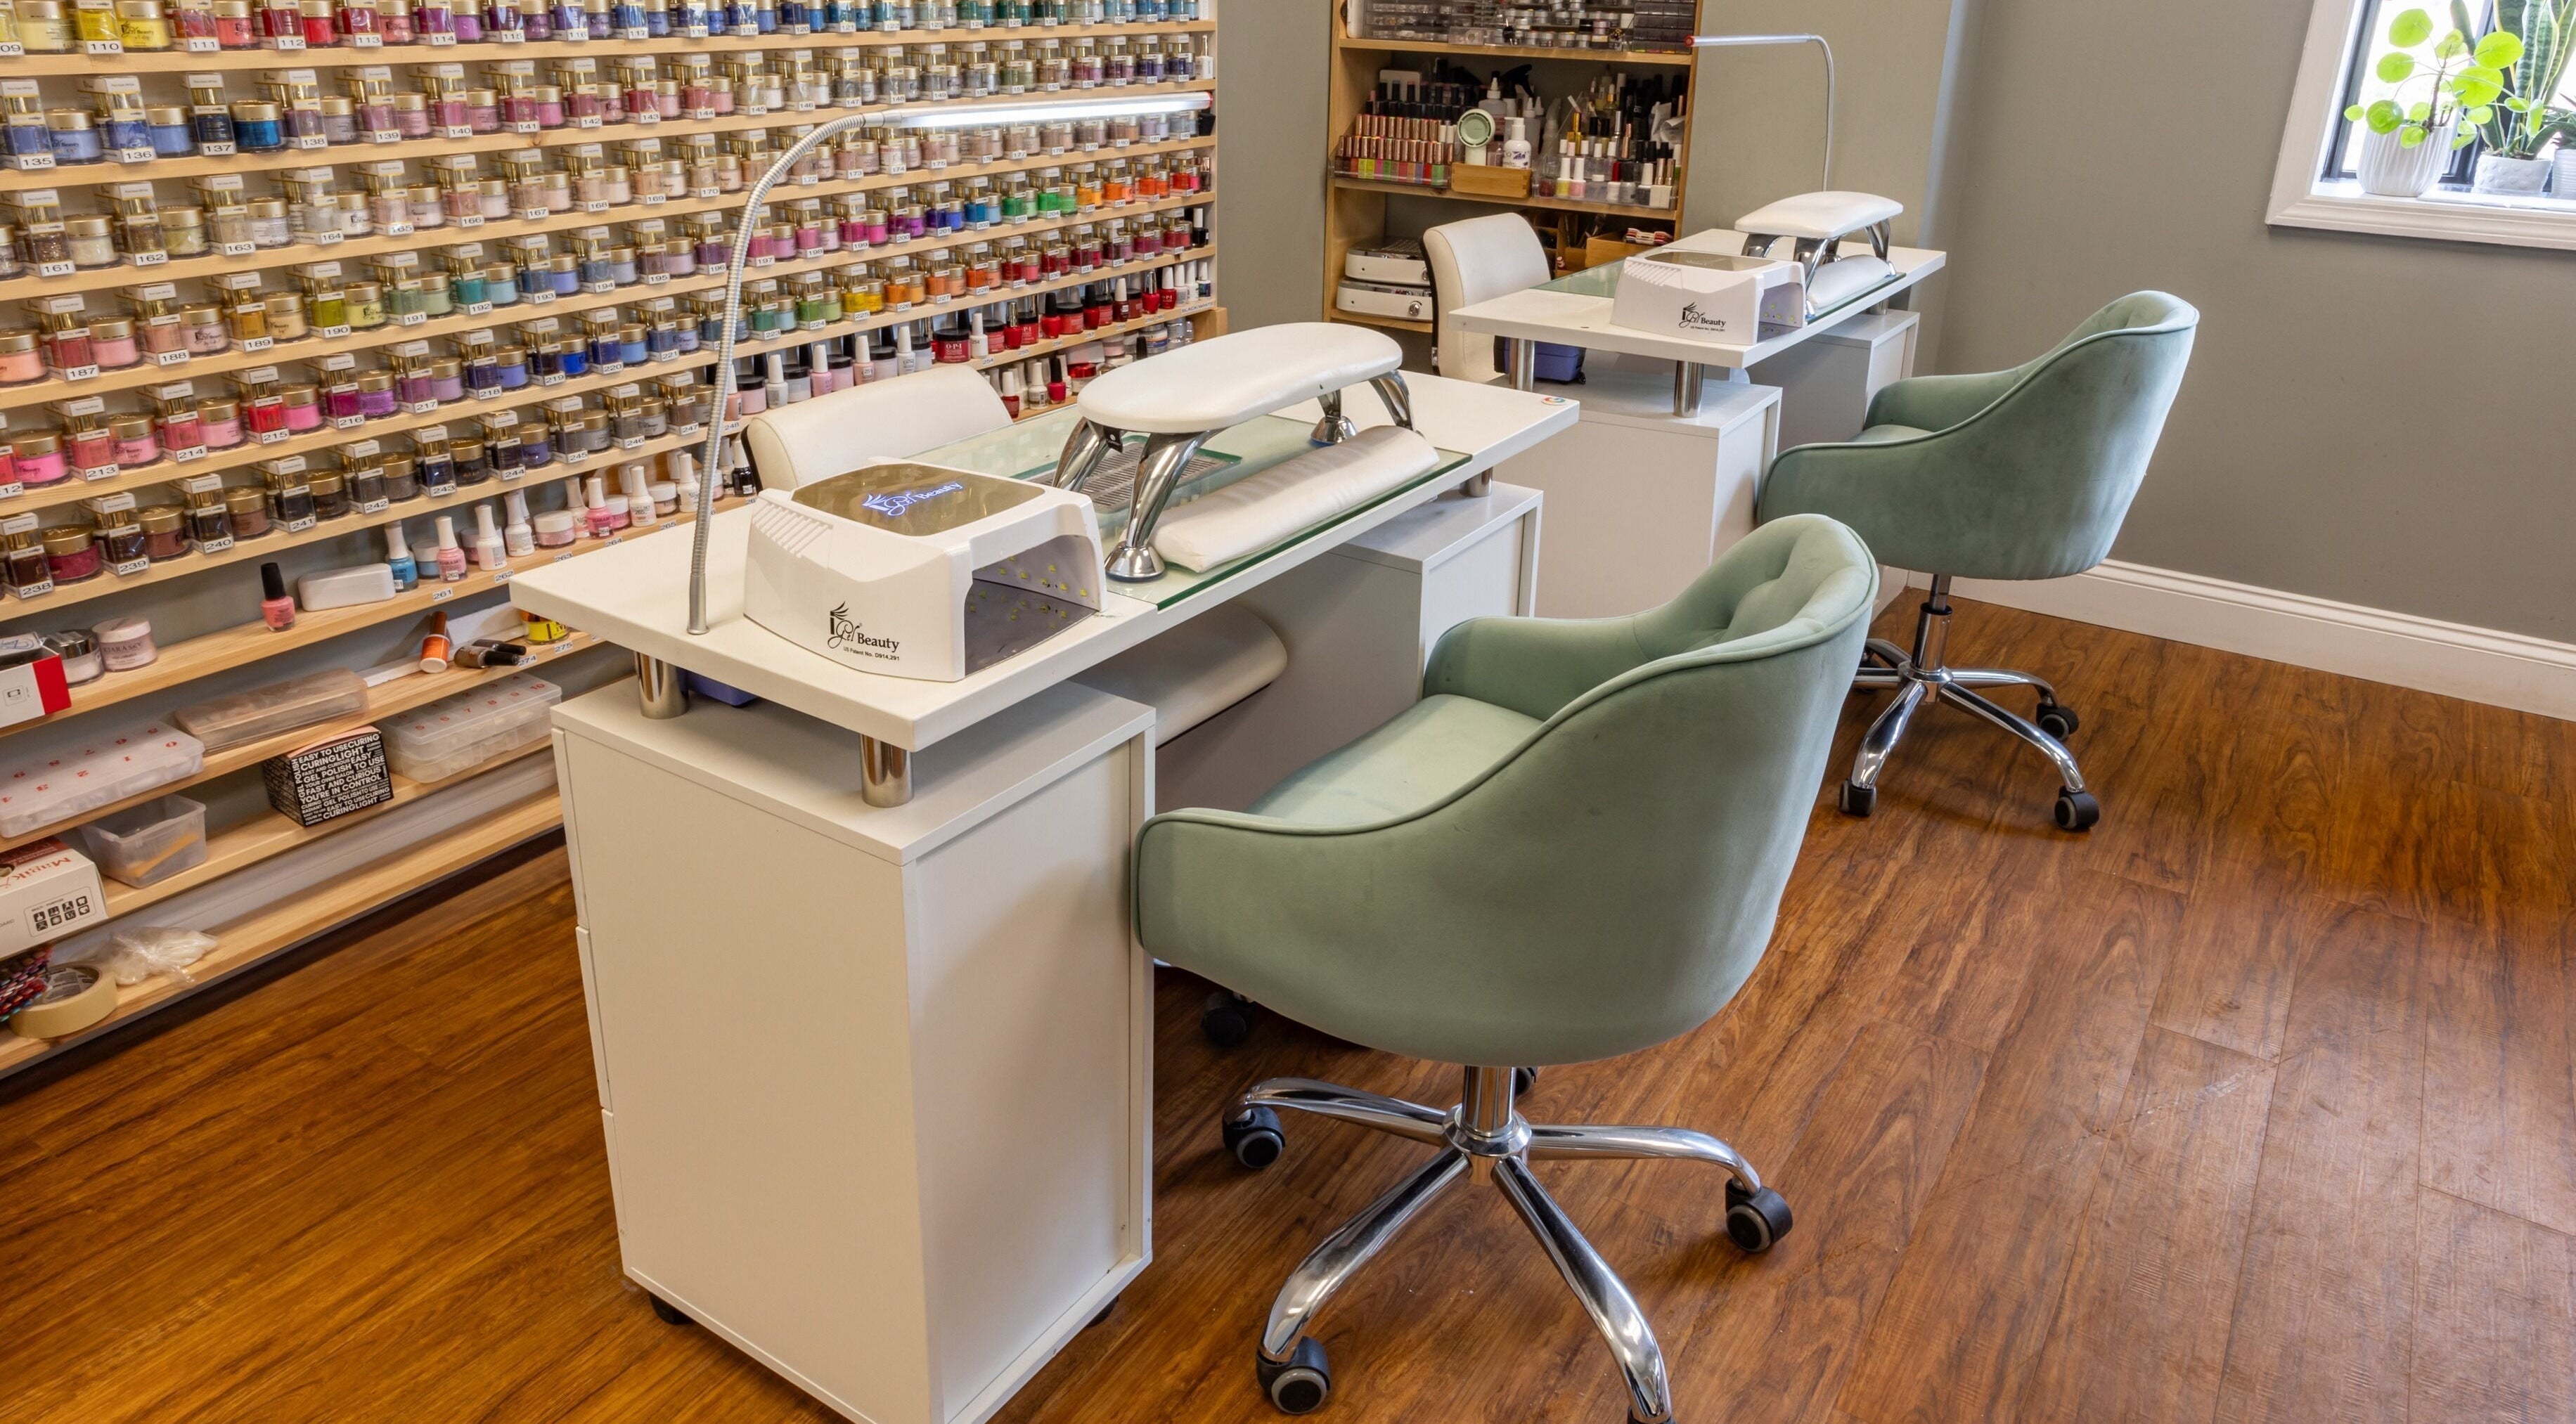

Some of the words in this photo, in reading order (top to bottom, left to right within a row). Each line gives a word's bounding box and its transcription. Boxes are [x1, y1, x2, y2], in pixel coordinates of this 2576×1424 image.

[281, 39, 304, 47] 112
[358, 36, 380, 44] 113
[0, 44, 21, 53] 09
[90, 42, 120, 51] 110
[192, 41, 217, 49] 111
[751, 105, 766, 114] 145
[799, 101, 814, 110] 146
[642, 113, 659, 122] 143
[698, 109, 714, 117] 144
[519, 122, 537, 131] 141
[583, 117, 601, 127] 142
[378, 131, 399, 140] 139
[451, 127, 471, 136] 140
[303, 138, 326, 146] 138
[205, 144, 232, 153] 137
[125, 150, 153, 160] 136
[22, 157, 53, 167] 135
[591, 201, 608, 209] 168
[529, 209, 547, 217] 167
[463, 216, 482, 225] 166
[977, 221, 990, 229] 202
[392, 224, 413, 233] 165
[322, 232, 342, 241] 164
[227, 243, 252, 252] 163
[853, 241, 868, 250] 199
[807, 247, 823, 256] 198
[139, 253, 165, 263] 162
[757, 257, 774, 265] 197
[44, 264, 70, 273] 161
[709, 264, 726, 272] 196
[597, 281, 614, 290] 194
[536, 292, 555, 301] 193
[471, 302, 491, 311] 192
[1181, 302, 1213, 313] BLACK/WHITE
[406, 314, 425, 323] 191
[1701, 317, 1727, 328] Beauty
[810, 321, 825, 330] 224
[326, 326, 349, 335] 190
[765, 330, 781, 339] 223
[247, 339, 271, 348] 189
[162, 351, 187, 361] 188
[70, 368, 96, 377] 187
[603, 363, 622, 373] 220
[546, 374, 564, 384] 219
[479, 388, 500, 397] 218
[416, 401, 437, 410] 217
[340, 416, 363, 426] 216
[682, 425, 699, 433] 247
[724, 422, 740, 432] 248
[263, 431, 288, 441] 215
[626, 436, 645, 447] 246
[179, 448, 203, 459] 214
[569, 452, 588, 462] 245
[87, 467, 116, 478] 213
[505, 468, 525, 478] 244
[0, 485, 22, 495] 12
[432, 484, 456, 495] 243
[915, 482, 963, 499] Beauty
[366, 500, 388, 512] 242
[292, 518, 314, 529] 241
[206, 538, 231, 550] 240
[605, 538, 623, 547] 264
[555, 552, 572, 562] 263
[120, 559, 147, 572] 239
[494, 571, 514, 581] 262
[22, 583, 51, 595] 238
[433, 589, 452, 600] 261
[555, 642, 573, 653] 275
[857, 633, 900, 653] Beauty
[518, 654, 536, 666] 274
[347, 734, 380, 749] CURING
[298, 752, 319, 764] EASY
[333, 744, 349, 753] USE
[351, 751, 372, 764] EASY
[327, 758, 350, 769] CURIOUS
[354, 761, 367, 770] TO
[368, 755, 385, 765] USE
[304, 774, 321, 783] GEL
[321, 763, 352, 777] POLISH
[335, 770, 354, 779] SALON
[291, 758, 303, 784] POLISH
[297, 784, 305, 798] GEL
[306, 784, 326, 796] FAST
[328, 778, 344, 789] AND
[346, 766, 381, 782] CURIOUS
[331, 787, 340, 795] IN
[342, 774, 382, 791] CONTROL
[365, 787, 390, 799] CURING
[301, 800, 322, 810] CURING
[323, 798, 337, 807] GEL
[327, 803, 343, 811] EASY
